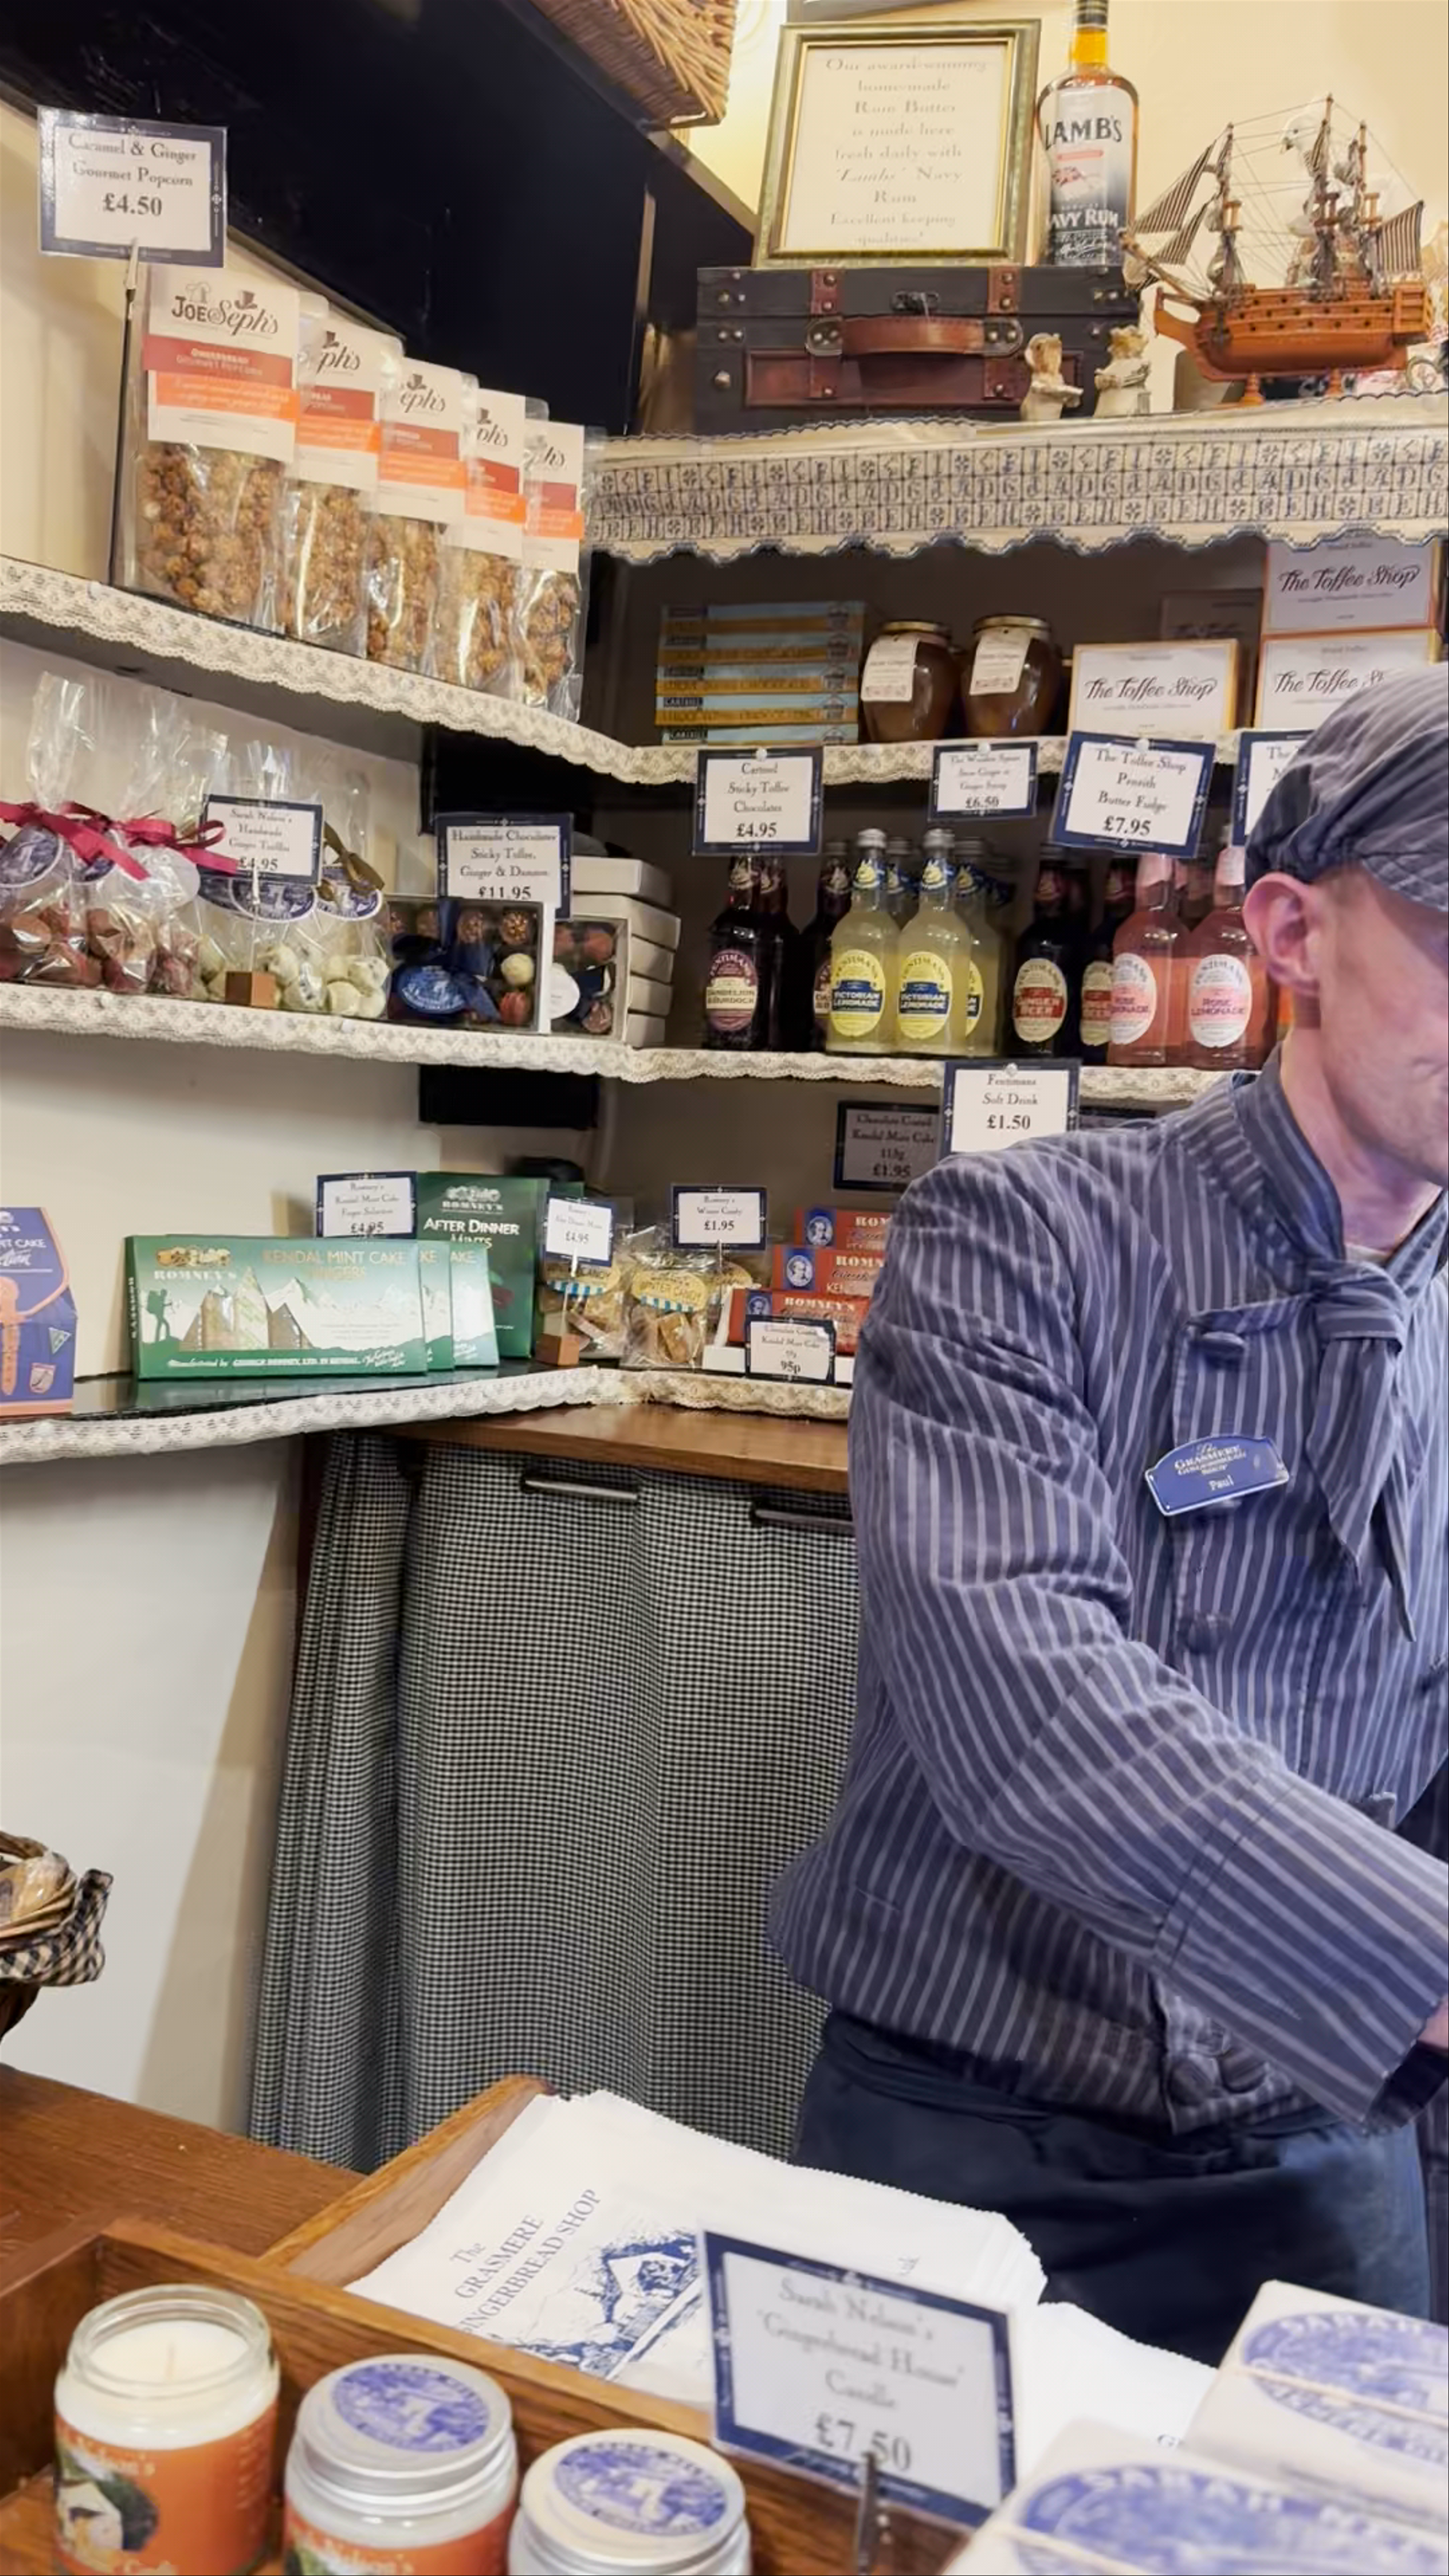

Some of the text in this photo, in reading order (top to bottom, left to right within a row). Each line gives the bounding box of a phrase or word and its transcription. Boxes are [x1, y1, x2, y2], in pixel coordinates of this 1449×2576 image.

[826, 58, 860, 71] Our
[1046, 115, 1122, 150] LAMB'S
[69, 133, 197, 165] Caramel & Ginger
[73, 159, 193, 188] Gourmet Popcorn
[103, 193, 163, 216] £4.50
[1051, 212, 1083, 228] AVY
[172, 295, 207, 322] JOE
[1278, 564, 1420, 592] The Toffee Shop
[1084, 677, 1218, 701] The Toffee Shop
[1275, 670, 1303, 693] The
[1307, 669, 1358, 694] Toffee
[741, 762, 778, 774] Cartmel
[1097, 750, 1186, 775] The Toffee Shop
[1117, 772, 1156, 789] Penrith
[728, 781, 790, 798] Sticky Toffee
[734, 800, 783, 812] Chocolates
[1098, 790, 1168, 814] Butter Fudge
[736, 822, 777, 838] £4.95
[1103, 815, 1151, 836] £7.95
[471, 847, 501, 863] Sticky
[460, 865, 492, 879] Ginger
[495, 866, 505, 877] &
[479, 886, 531, 900] £11.95
[986, 1073, 1037, 1086] Fentimans
[982, 1093, 1038, 1105] Soft Drink
[986, 1114, 1031, 1130] £1.50
[423, 1217, 520, 1235] AFTER DINNER
[704, 1220, 735, 1230] £1.95
[15, 1238, 47, 1248] CAKE
[327, 1250, 365, 1264] MINT
[369, 1251, 407, 1265] CAKE
[420, 1250, 437, 1264] KE
[450, 1250, 477, 1264] AKE
[154, 1270, 237, 1280] ROMNEY'S
[784, 1297, 855, 1311] ROMNEY'S
[780, 1360, 801, 1374] 95p
[1209, 1475, 1234, 1491] Paul
[556, 2189, 601, 2235] SHOP
[449, 2242, 486, 2264] The
[454, 2215, 544, 2299] GRASMERE
[778, 2277, 933, 2340] Sarah Nelson's
[825, 2369, 896, 2409] Candle
